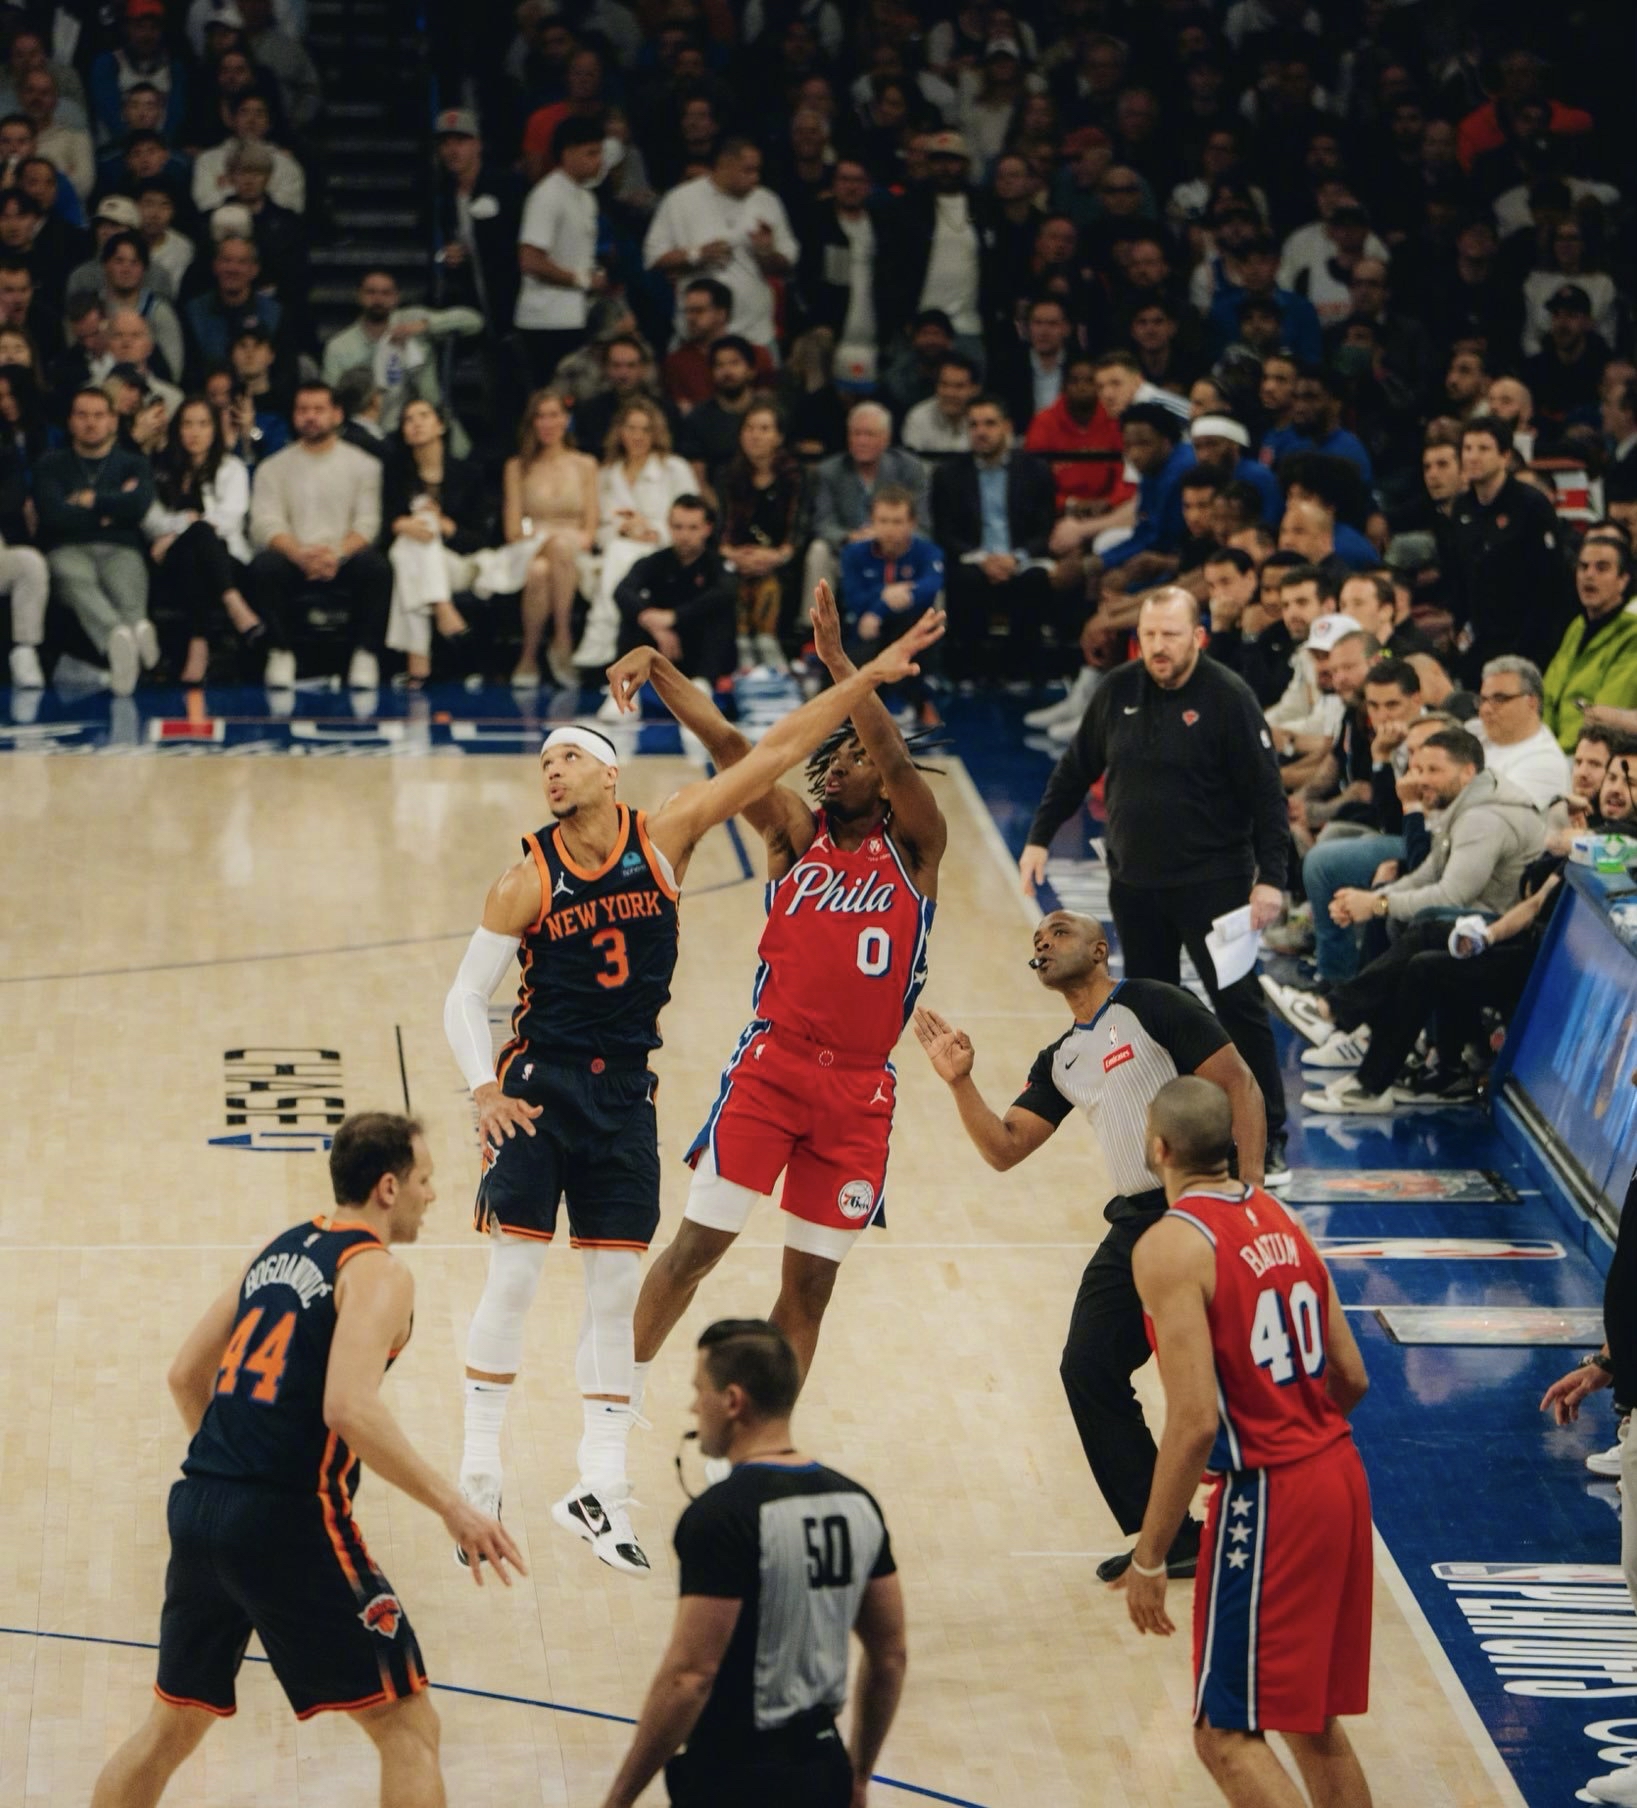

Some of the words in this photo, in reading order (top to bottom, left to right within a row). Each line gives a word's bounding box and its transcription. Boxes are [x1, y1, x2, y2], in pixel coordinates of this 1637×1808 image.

[545, 900, 597, 941] NEW
[600, 890, 662, 923] YORK
[785, 862, 896, 916] Phila
[591, 927, 630, 988] 3
[857, 926, 892, 979] 0
[1239, 1233, 1301, 1278] BATUM
[214, 1306, 297, 1404] 44
[1250, 1281, 1327, 1387] 40
[803, 1514, 853, 1591] 50
